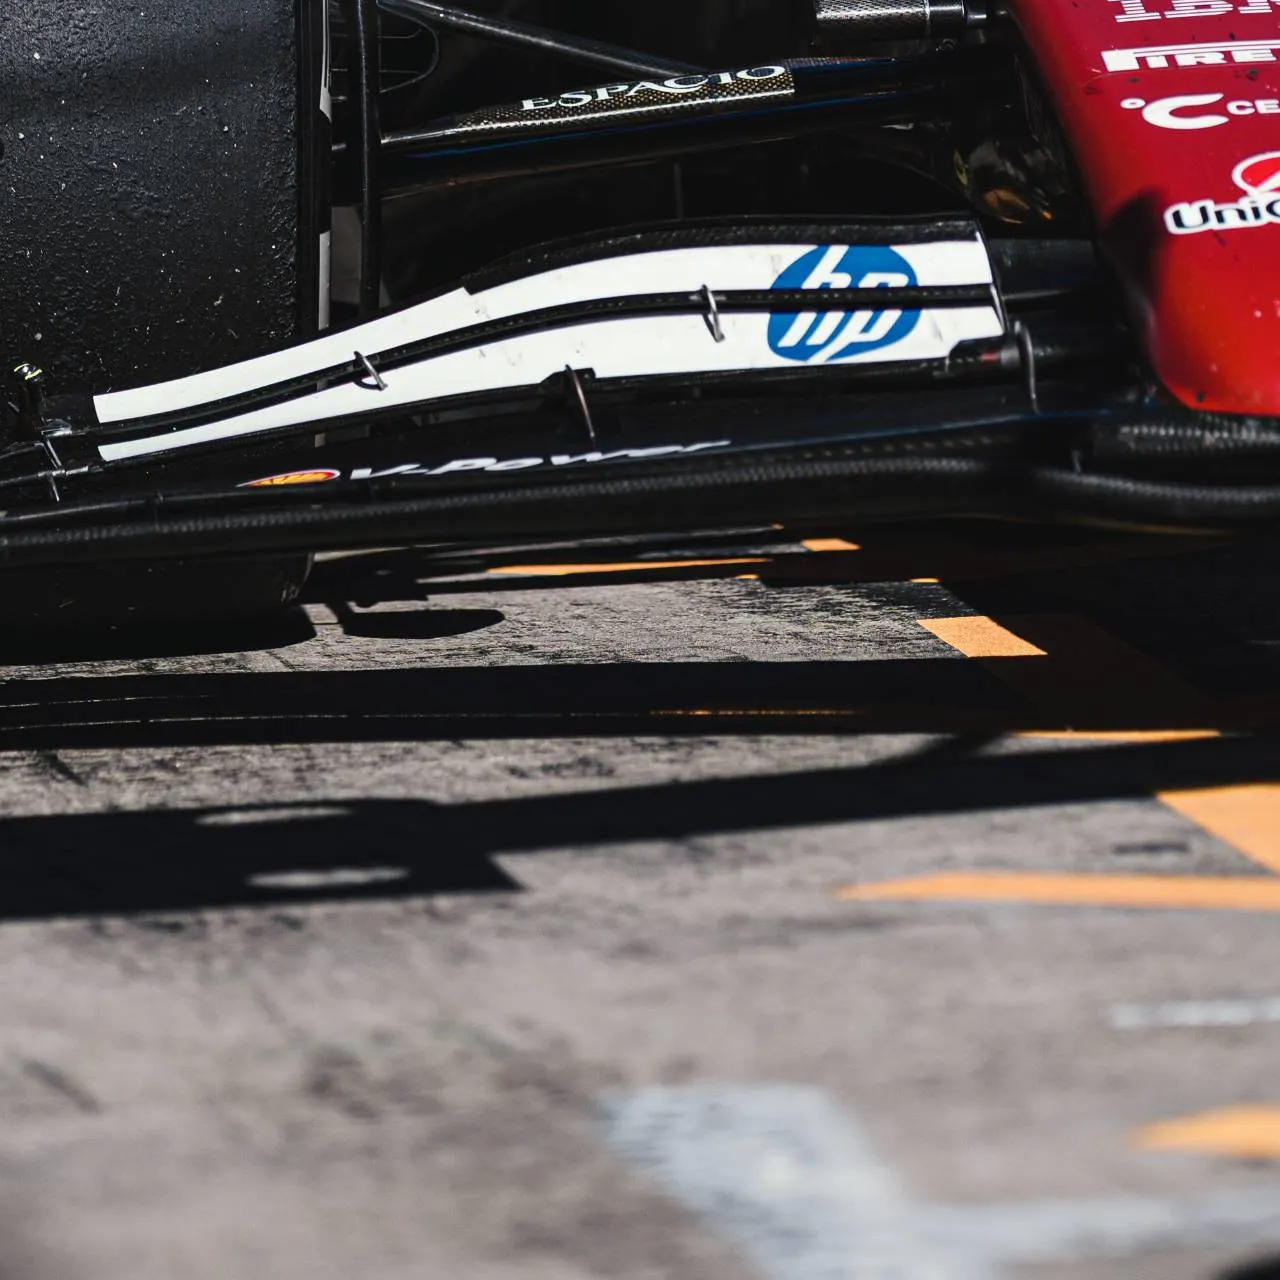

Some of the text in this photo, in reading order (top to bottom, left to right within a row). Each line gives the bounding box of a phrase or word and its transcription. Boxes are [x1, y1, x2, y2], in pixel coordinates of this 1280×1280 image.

[521, 65, 787, 111] ESPACIO
[776, 244, 910, 363] hp
[350, 439, 732, 480] V-Power
